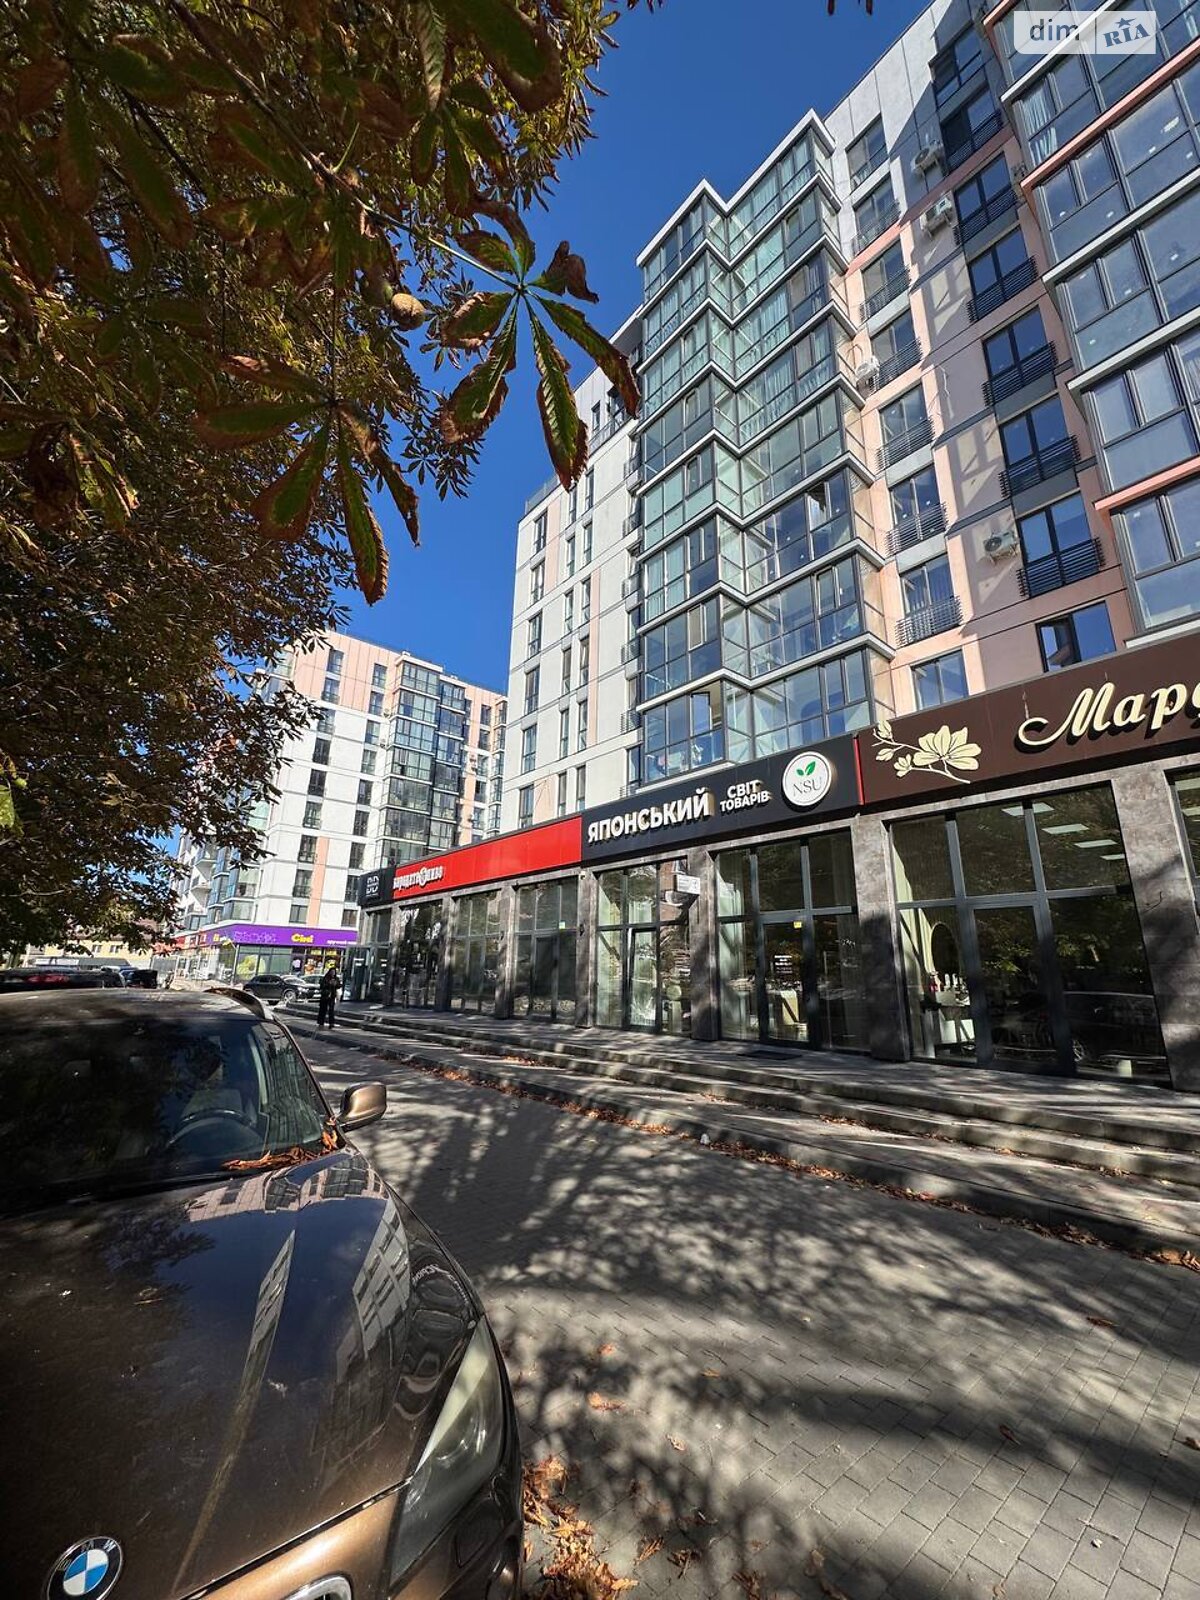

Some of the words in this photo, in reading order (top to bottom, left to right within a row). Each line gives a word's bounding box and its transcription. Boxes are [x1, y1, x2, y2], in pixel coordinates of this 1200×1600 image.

[1018, 682, 1200, 746] Мар
[727, 779, 761, 799] СВІТ
[793, 776, 822, 797] NSU
[719, 790, 770, 812] ТОВАРІВ
[587, 787, 712, 843] ЯПОНСЬКИЙ
